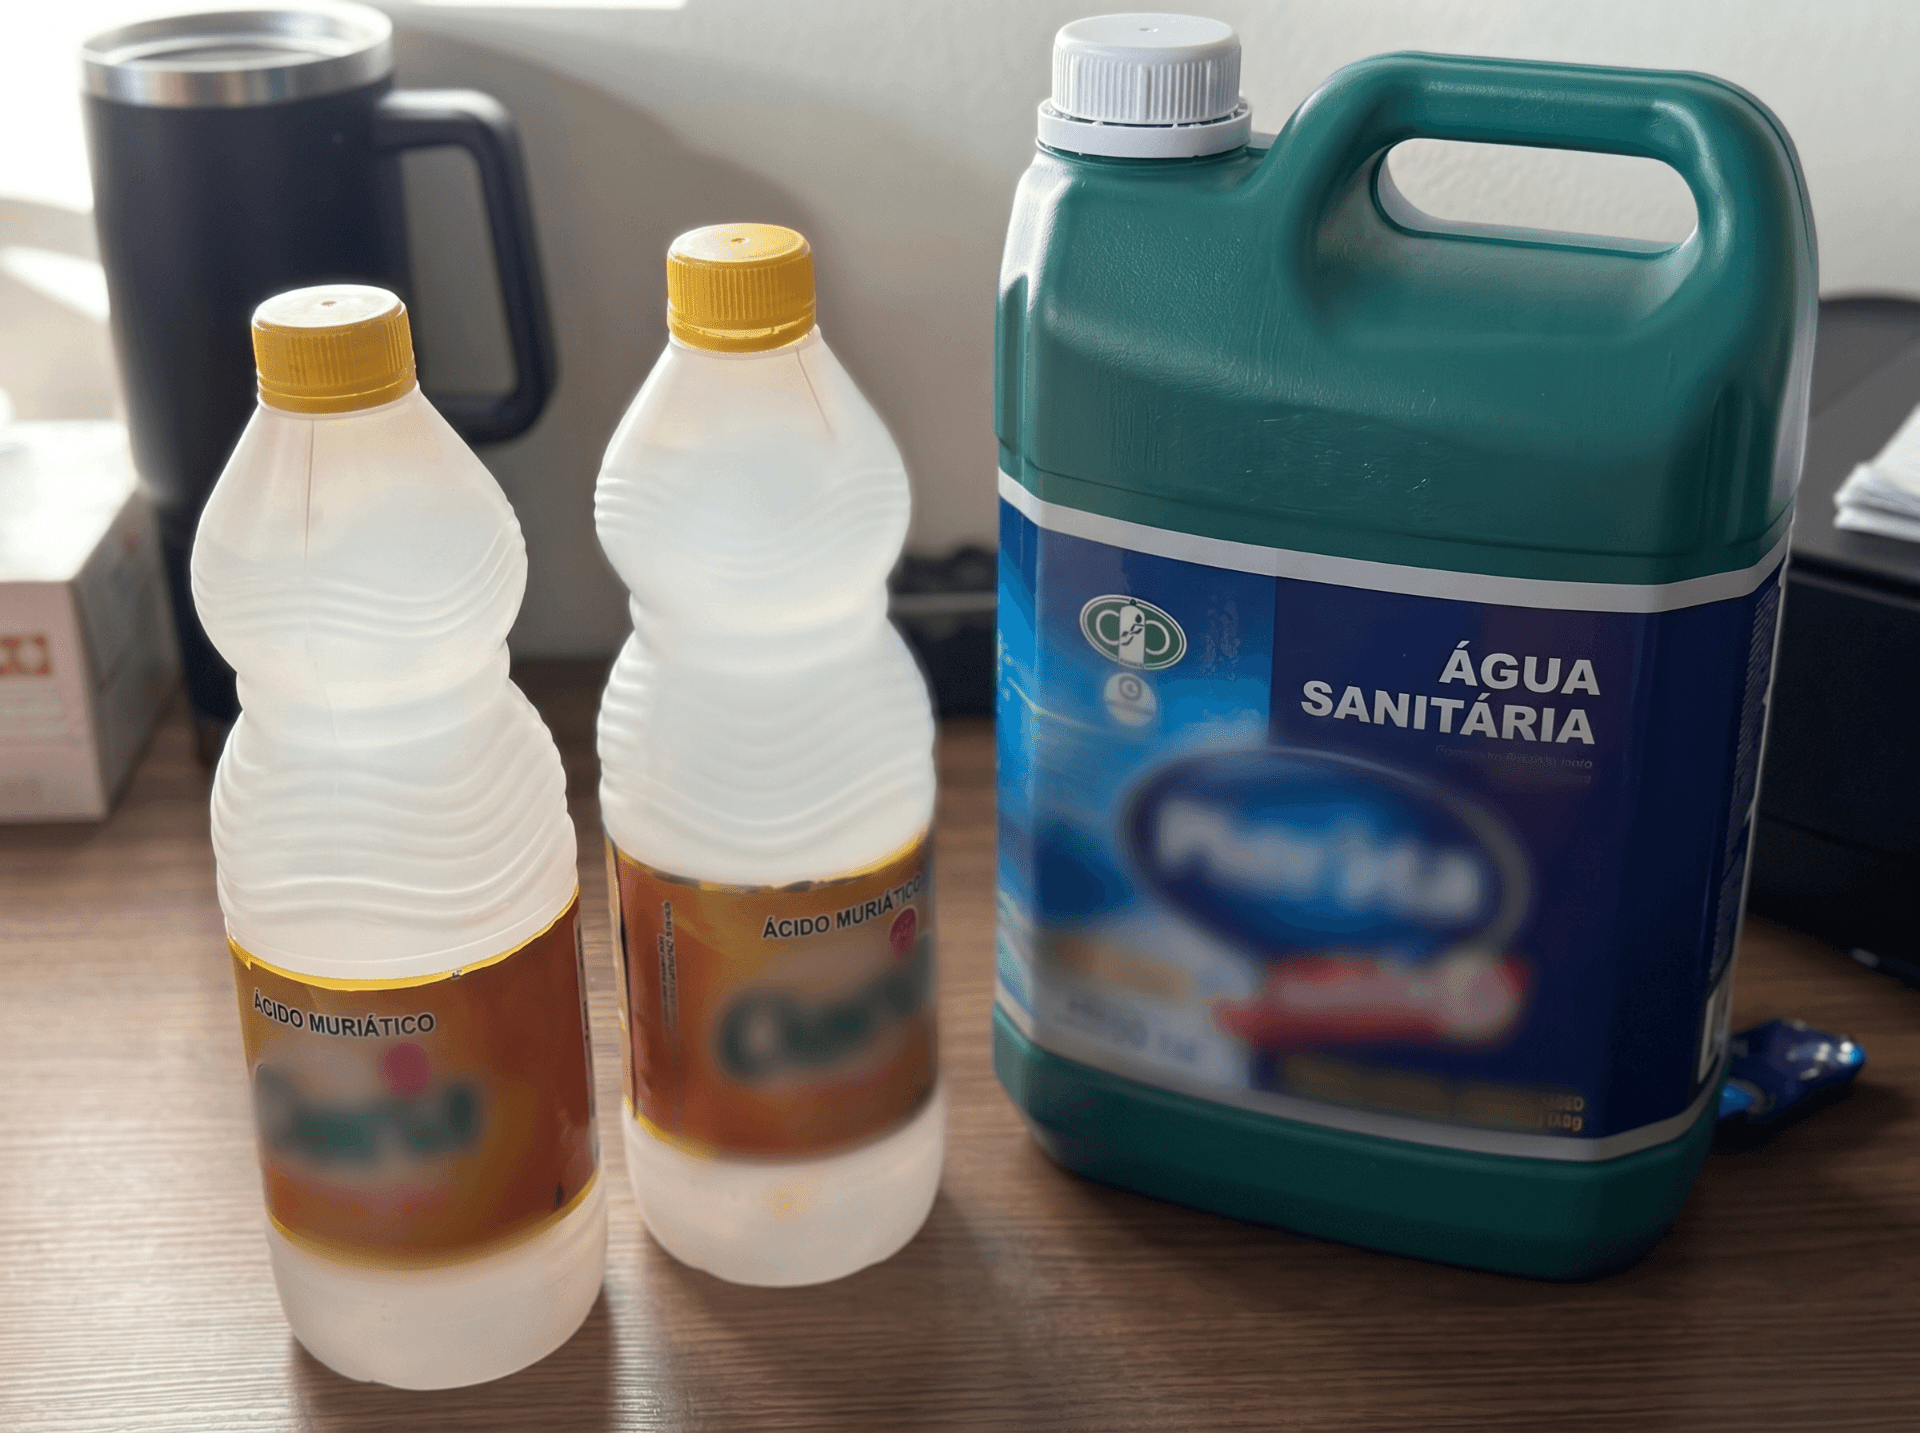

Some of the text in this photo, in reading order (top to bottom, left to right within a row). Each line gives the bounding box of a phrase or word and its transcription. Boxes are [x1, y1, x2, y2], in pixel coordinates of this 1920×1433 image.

[1438, 640, 1601, 696] ÁGUA
[1300, 680, 1596, 745] SANITÁRIA
[762, 874, 922, 939] ÁCIDO MURIÁTICO
[253, 988, 435, 1037] ÁCIDO MURIÁTICO
